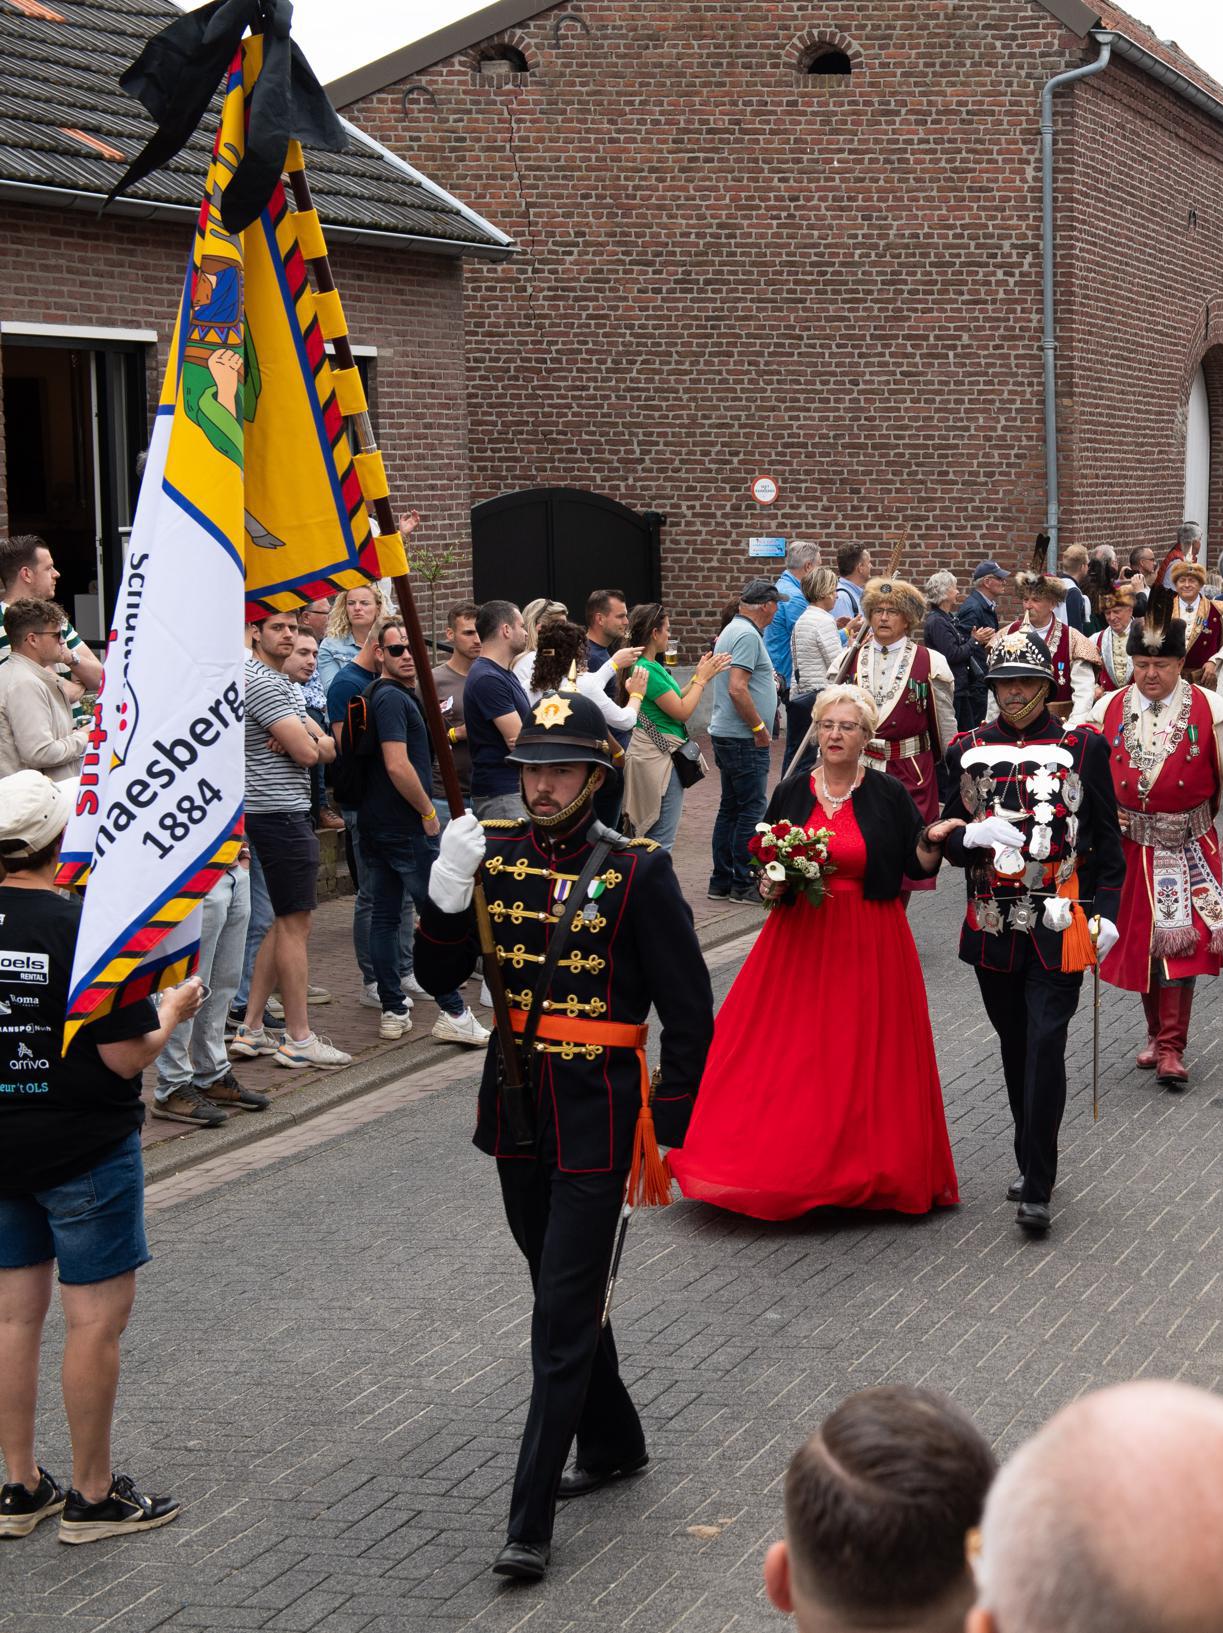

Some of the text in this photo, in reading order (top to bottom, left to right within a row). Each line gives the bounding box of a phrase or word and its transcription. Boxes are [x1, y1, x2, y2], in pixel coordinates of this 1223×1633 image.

[142, 777, 223, 860] 1884
[20, 972, 45, 981] RENTAL
[9, 993, 39, 1004] Roma
[9, 1058, 50, 1070] arriva
[26, 1082, 49, 1094] OLS
